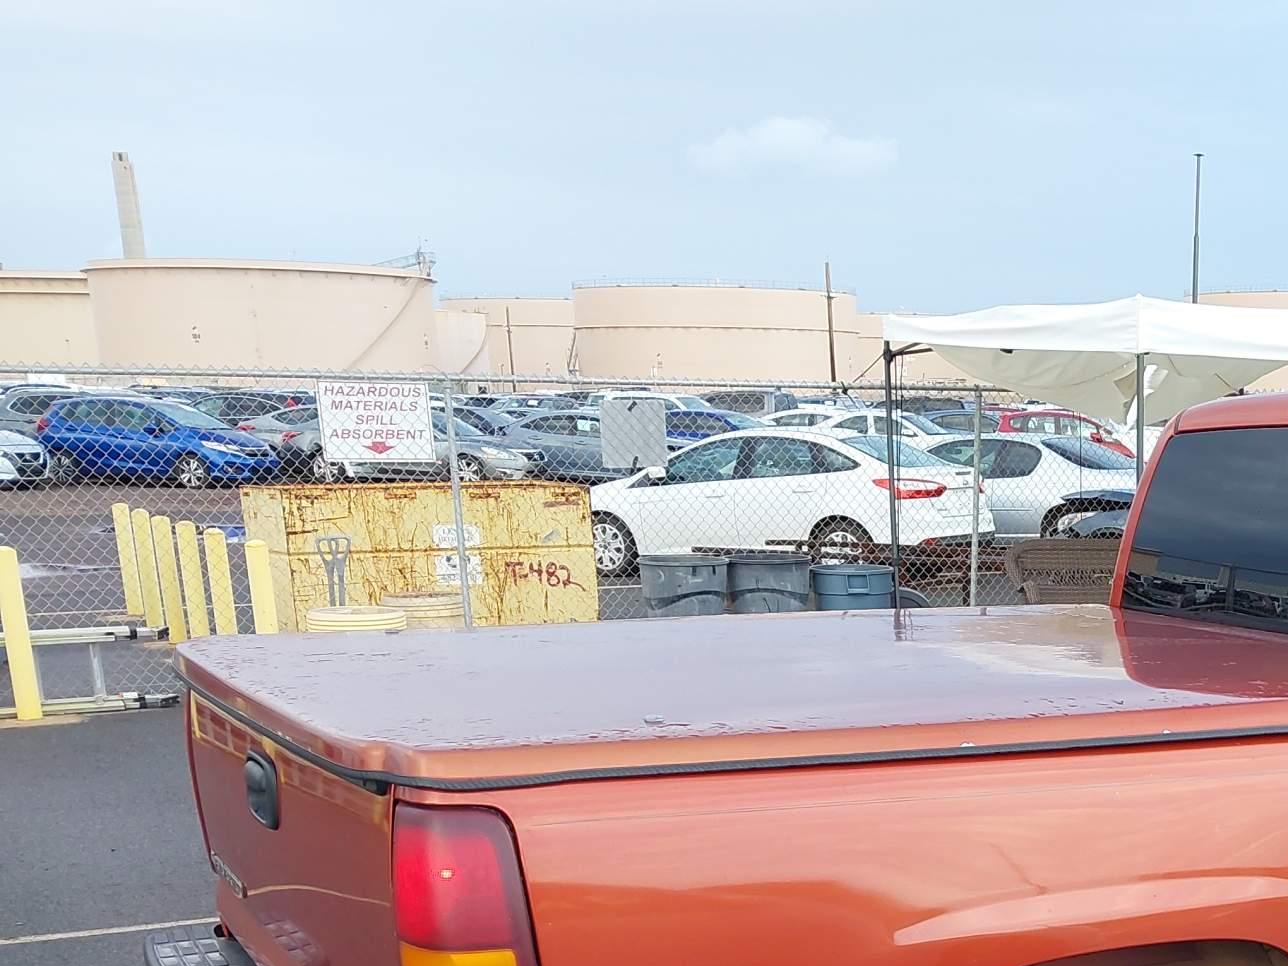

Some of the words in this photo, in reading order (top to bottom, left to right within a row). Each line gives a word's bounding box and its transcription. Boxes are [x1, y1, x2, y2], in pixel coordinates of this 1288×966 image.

[324, 385, 421, 398] HAZARDOUS
[330, 400, 418, 412] MATERIALS
[355, 414, 398, 426] SPILL
[329, 428, 426, 440] ABSORBENT
[505, 559, 586, 592] T-482
